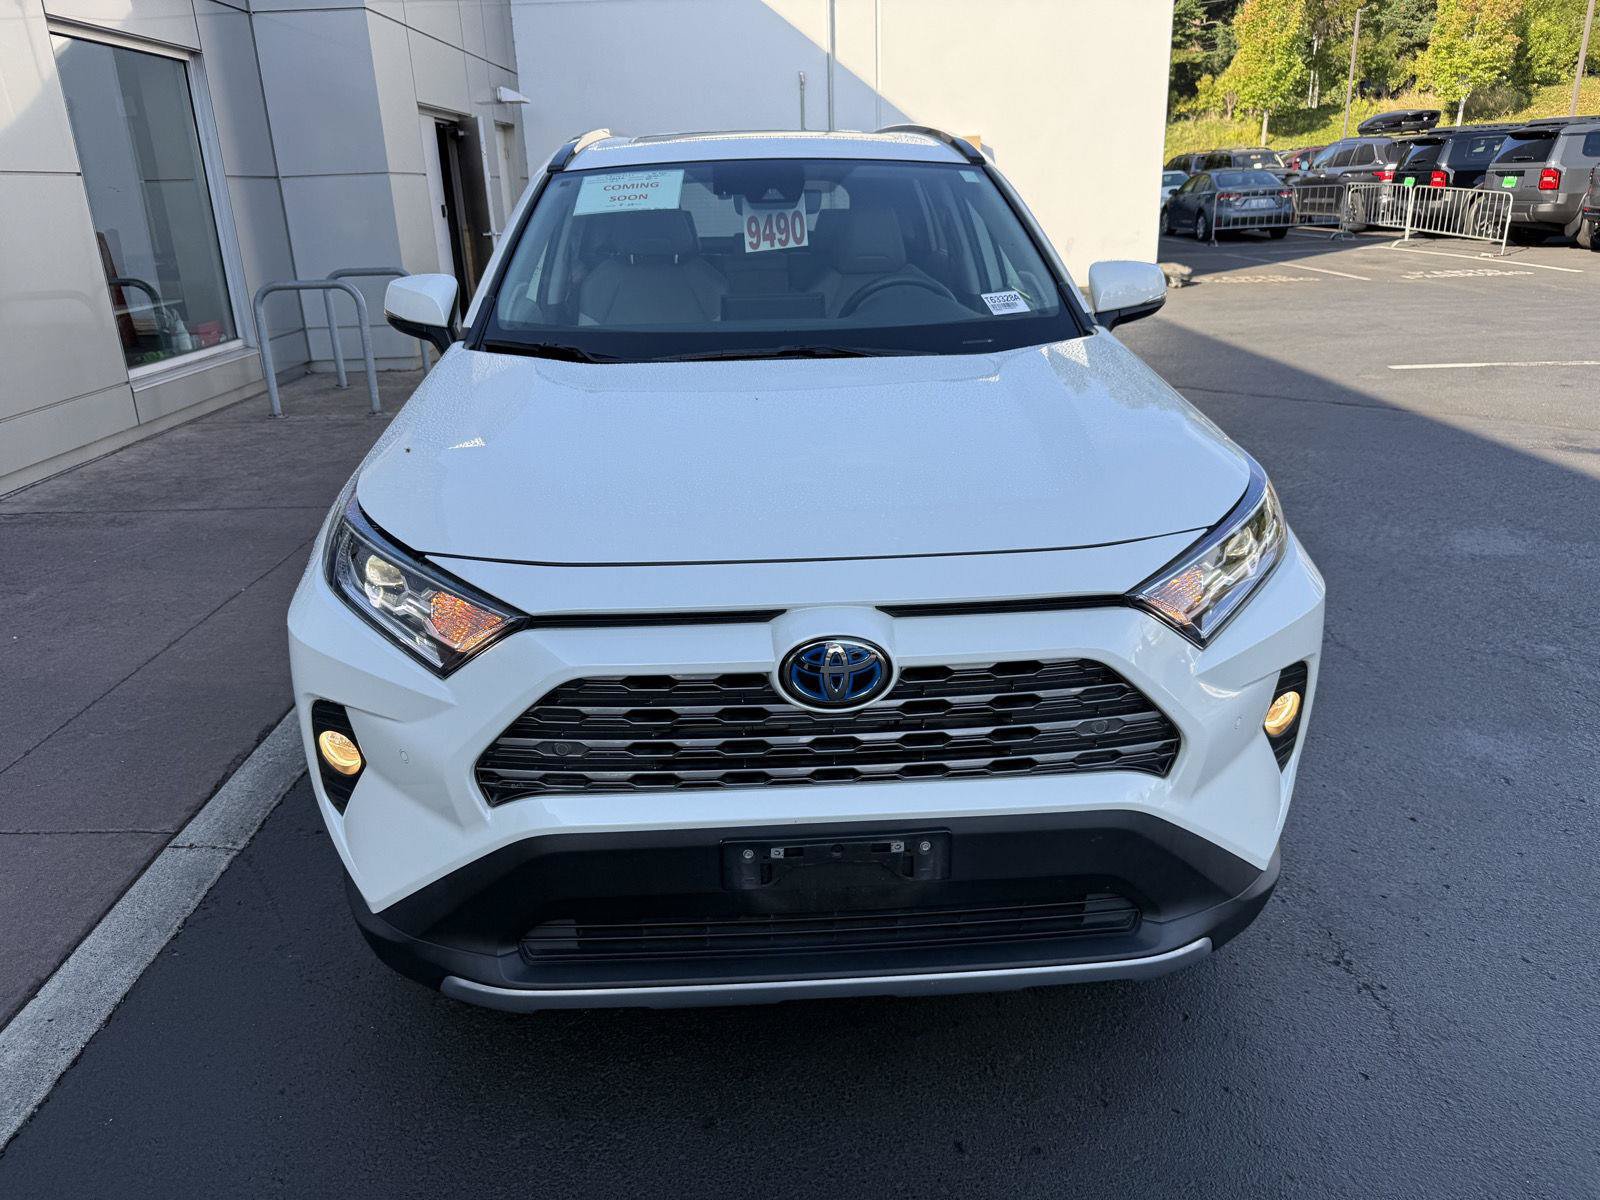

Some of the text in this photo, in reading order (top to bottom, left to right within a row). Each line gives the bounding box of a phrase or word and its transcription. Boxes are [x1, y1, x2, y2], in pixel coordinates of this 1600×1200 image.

[603, 181, 660, 192] COMING
[609, 193, 648, 203] SOON
[747, 210, 805, 251] 9490
